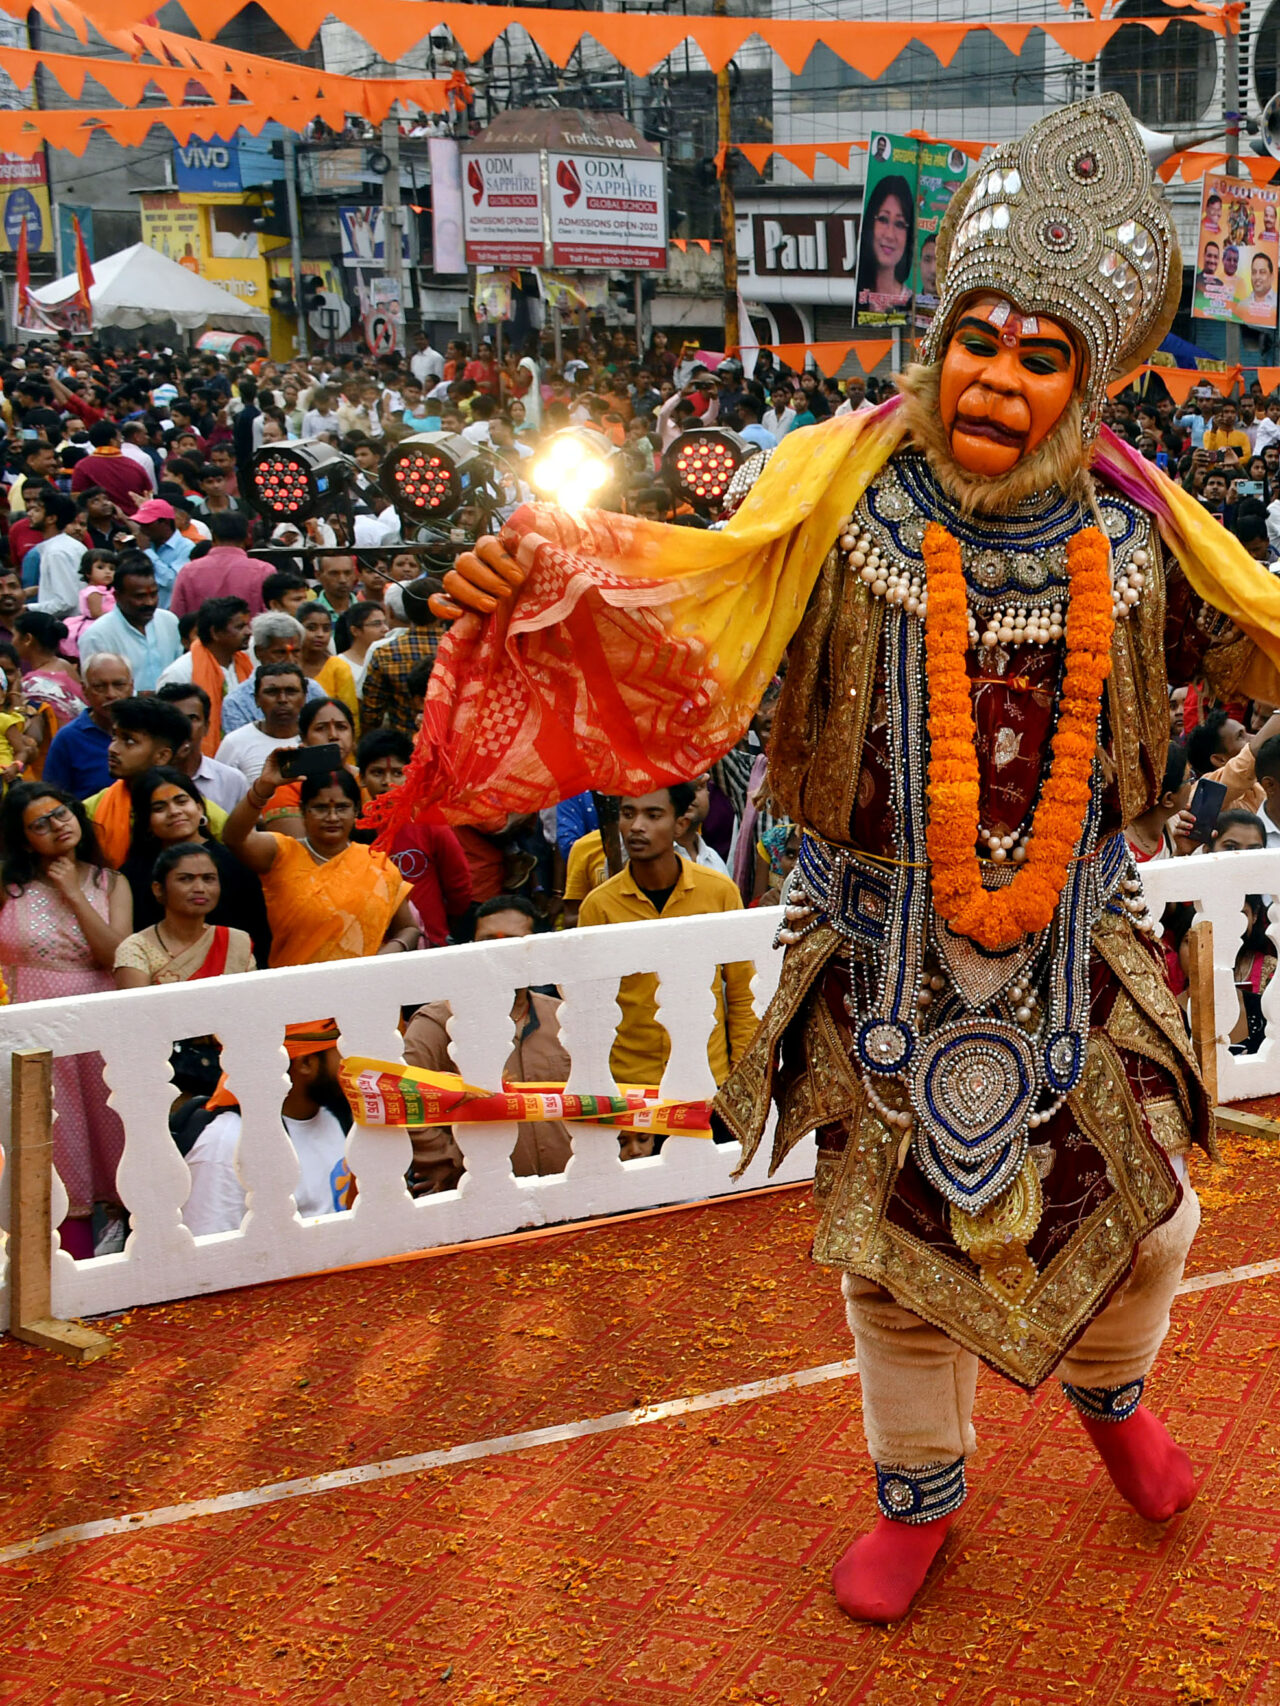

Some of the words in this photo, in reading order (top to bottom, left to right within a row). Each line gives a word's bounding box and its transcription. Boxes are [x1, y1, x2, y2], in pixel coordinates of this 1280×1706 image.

[561, 132, 604, 147] Traffic
[605, 133, 638, 149] Post
[485, 158, 513, 174] ODM
[585, 161, 624, 178] ODM
[486, 177, 537, 191] SAPPHIRE
[585, 180, 656, 198] SAPPHIRE
[488, 195, 511, 206] GLOBAL
[512, 195, 536, 206] SCHOOL
[589, 199, 620, 210] GLOBAL
[622, 201, 655, 212] SCHOOL
[558, 218, 611, 229] ADMISSIONS
[613, 219, 658, 231] OPEN-2023
[763, 219, 828, 270] Paul
[569, 254, 583, 263] Toll
